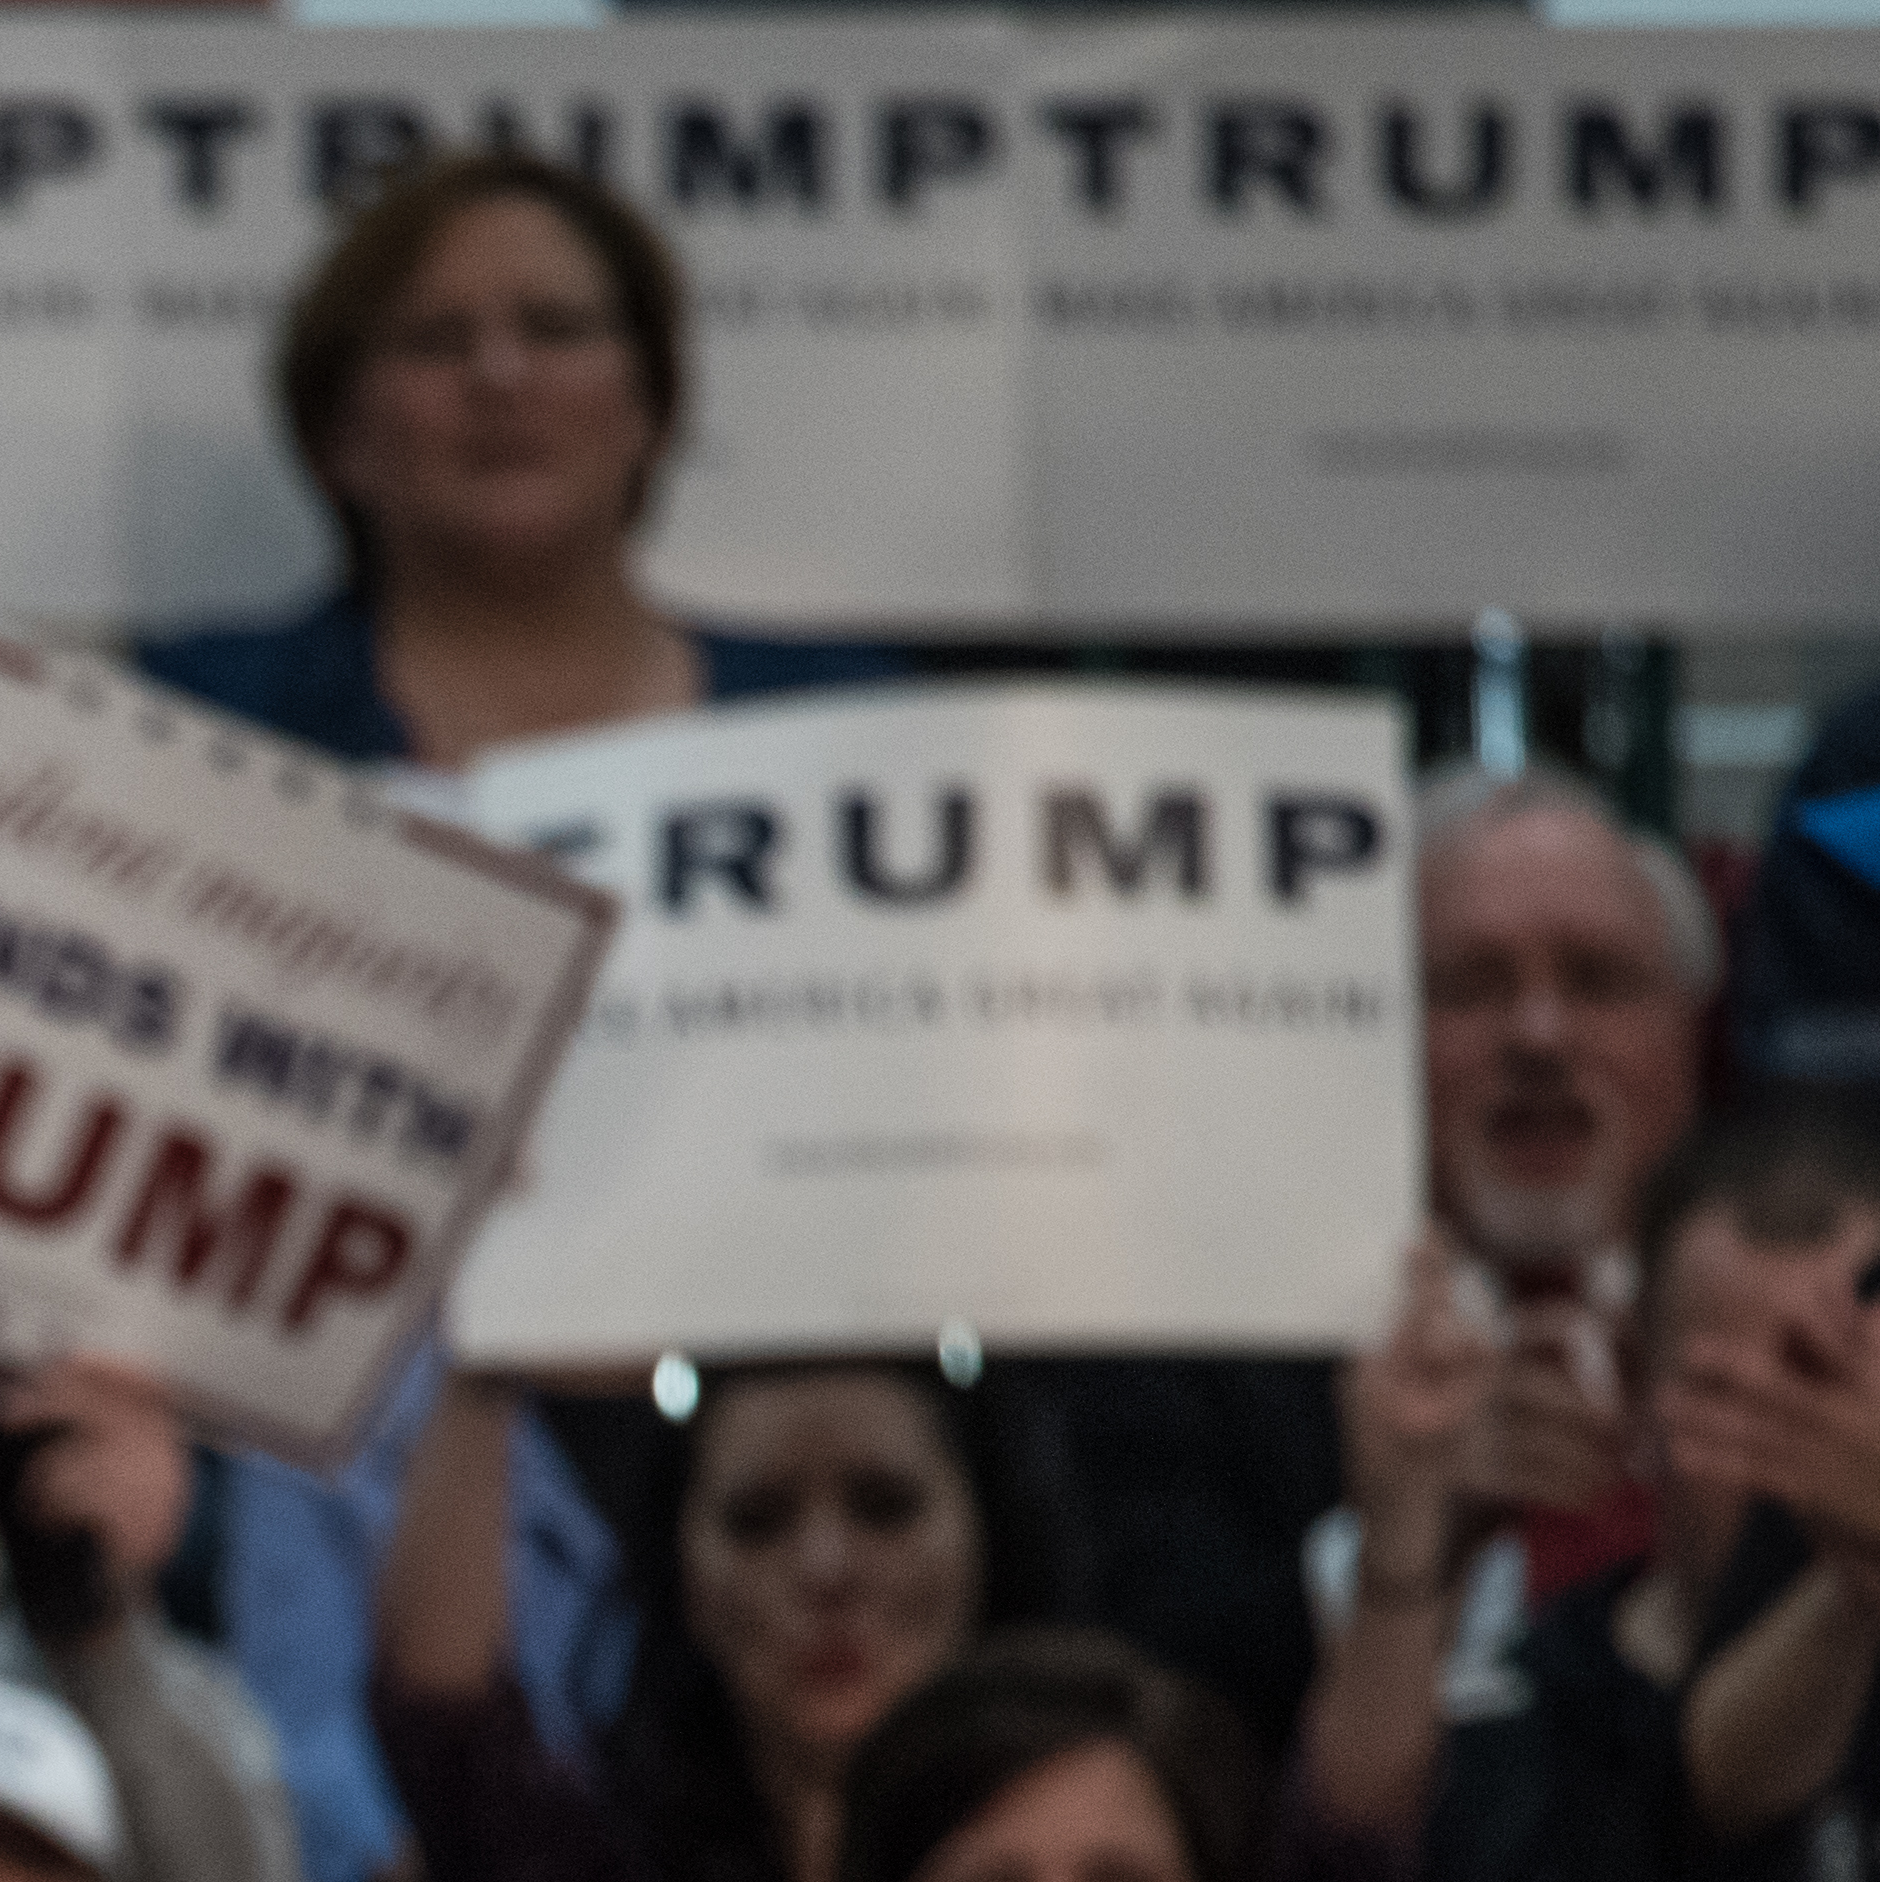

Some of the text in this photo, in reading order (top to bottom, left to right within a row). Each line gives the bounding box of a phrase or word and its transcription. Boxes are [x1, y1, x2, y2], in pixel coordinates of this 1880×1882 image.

[1039, 92, 1880, 218] TRUMP
[524, 775, 1387, 920] RUMP
[206, 995, 484, 1168] WITH
